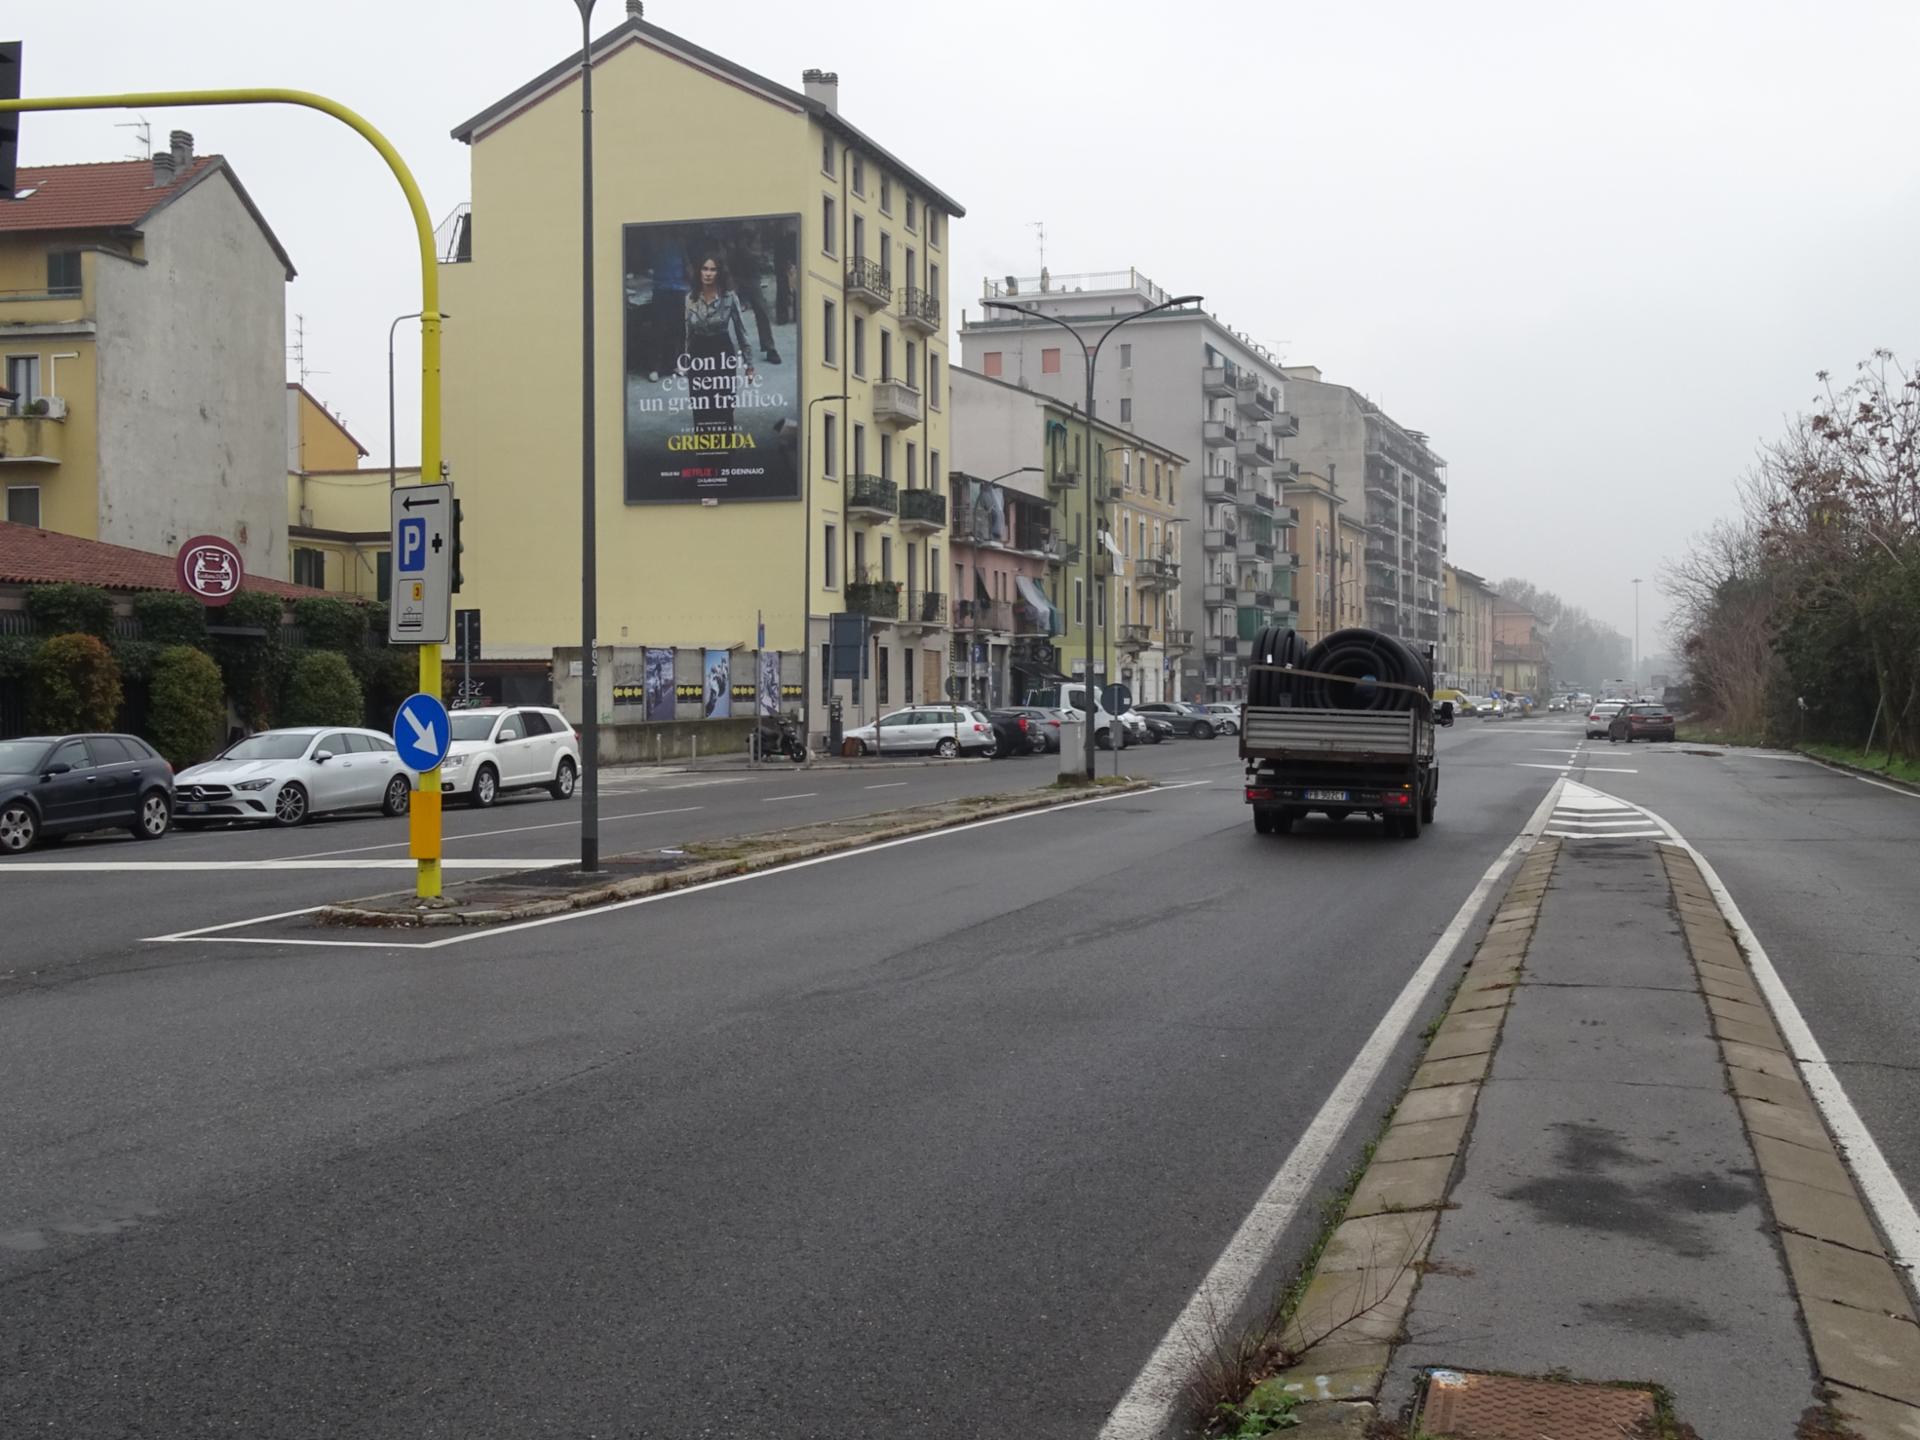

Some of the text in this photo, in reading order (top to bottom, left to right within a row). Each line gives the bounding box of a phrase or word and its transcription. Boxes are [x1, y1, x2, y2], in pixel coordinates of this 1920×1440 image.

[677, 353, 715, 371] Con
[662, 373, 763, 394] c'è sempre
[640, 389, 788, 415] un gran traffico.
[667, 433, 756, 451] GRISELDA
[681, 467, 713, 478] NETFLIX
[721, 468, 730, 476] 25
[731, 467, 765, 476] GENNAIO
[404, 525, 420, 565] P
